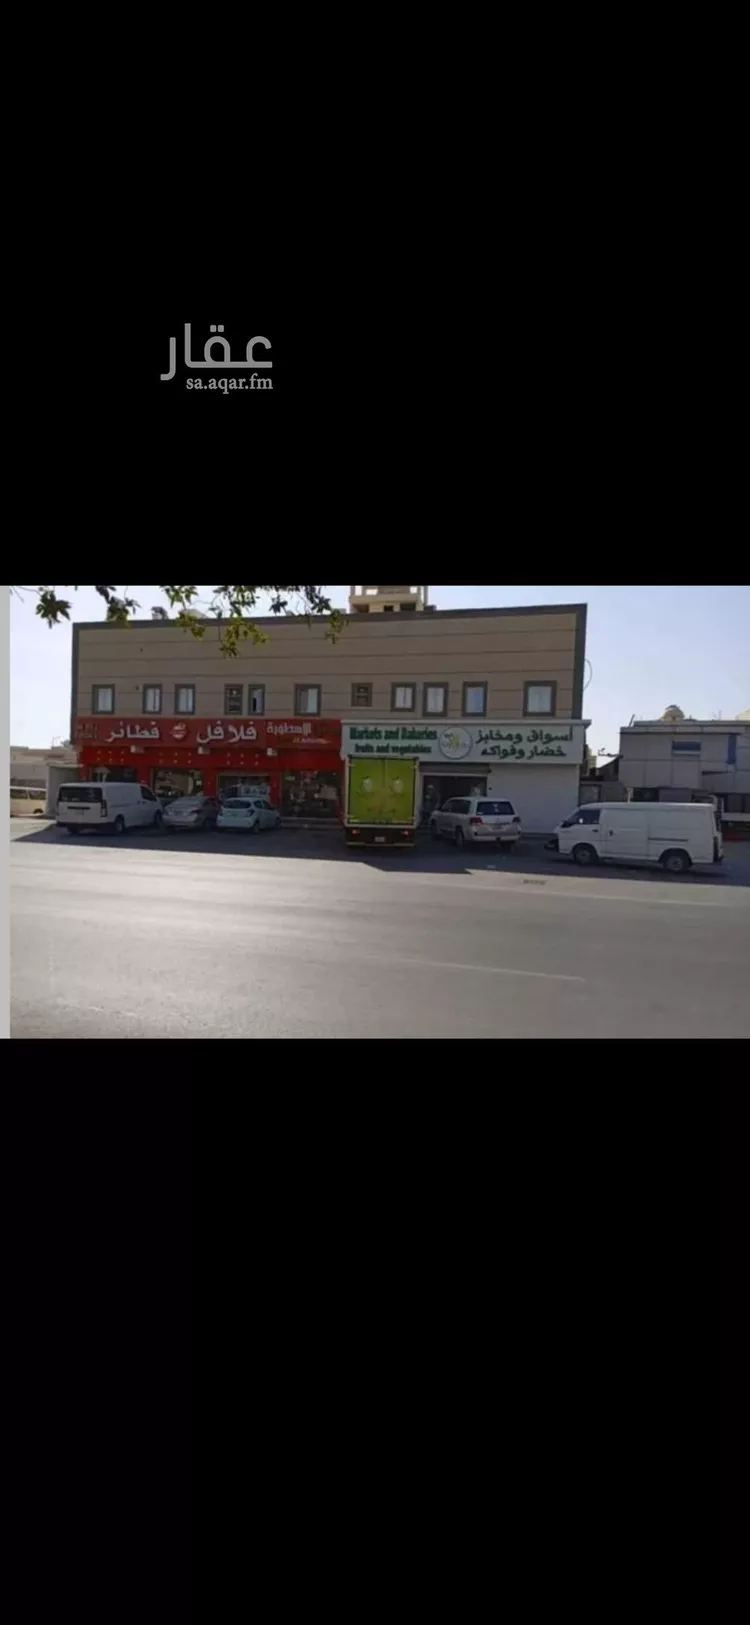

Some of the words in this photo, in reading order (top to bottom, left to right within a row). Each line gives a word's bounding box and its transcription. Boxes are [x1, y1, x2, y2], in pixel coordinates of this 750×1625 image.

[105, 720, 160, 742] فطائر
[196, 720, 257, 743] فلافل
[384, 727, 399, 740] and
[475, 729, 523, 745] ومخابز
[376, 743, 390, 753] and
[527, 745, 567, 760] خضار
